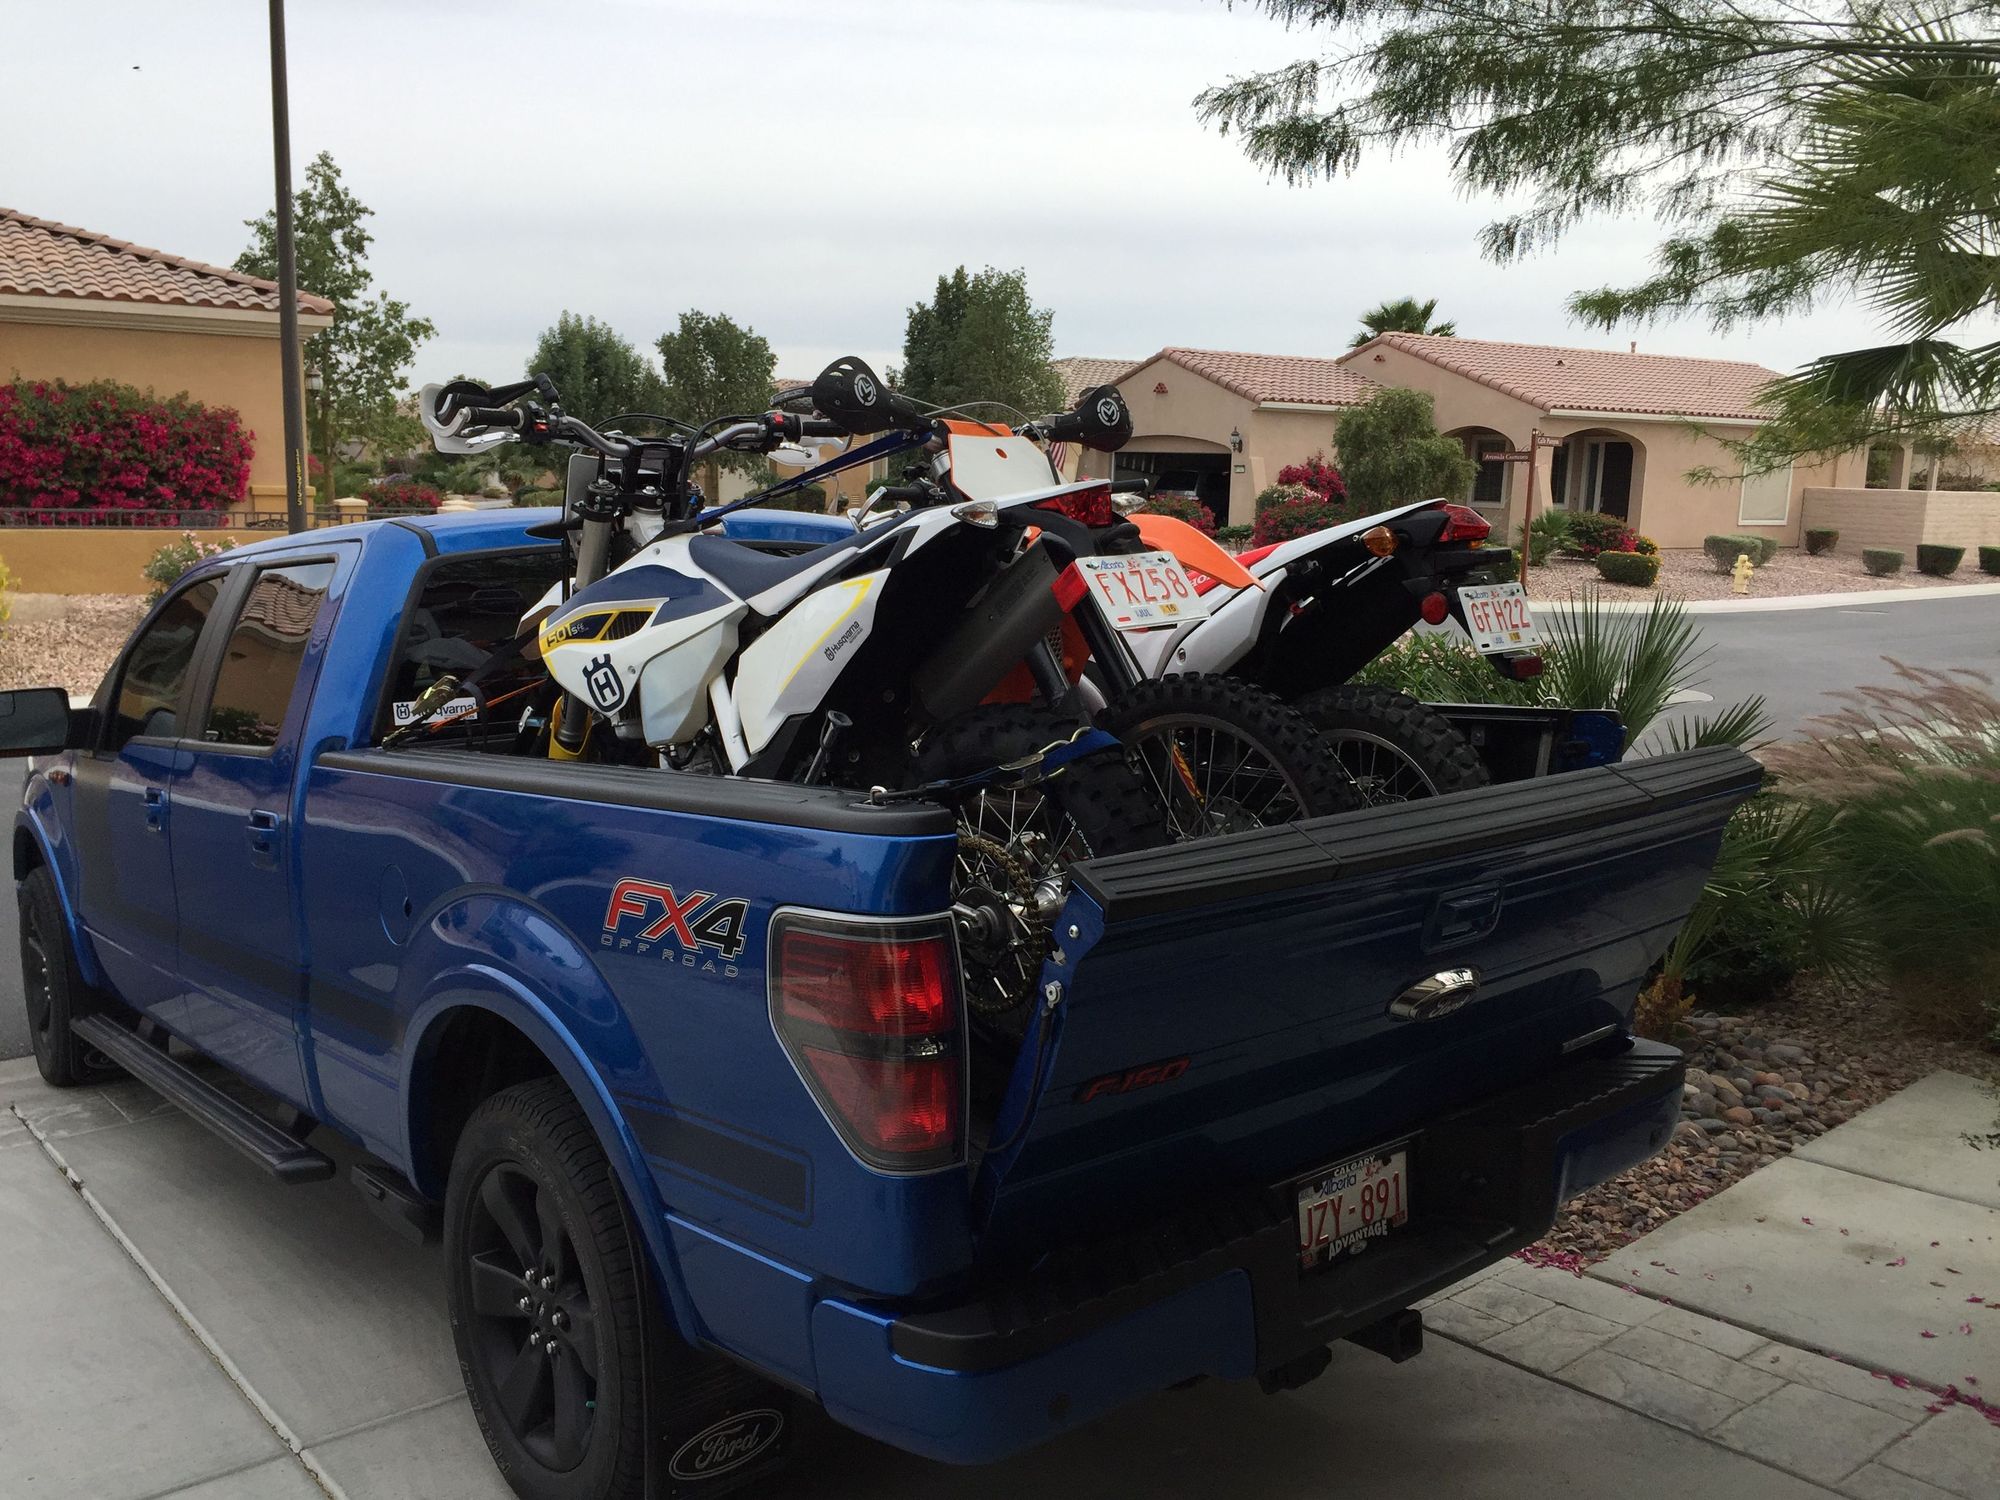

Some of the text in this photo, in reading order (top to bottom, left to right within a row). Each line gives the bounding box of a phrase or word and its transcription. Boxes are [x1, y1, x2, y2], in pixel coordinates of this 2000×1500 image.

[1095, 567, 1189, 606] FXZ58
[1471, 598, 1531, 632] GFH22
[831, 621, 860, 654] Husqvarna
[603, 877, 750, 961] FX4
[601, 933, 739, 978] OFF ROAD
[1320, 1173, 1357, 1197] Alberta
[1333, 1155, 1375, 1177] CALGARY
[1329, 1219, 1388, 1260] ADVANTAGE
[695, 1423, 760, 1469] Ford
